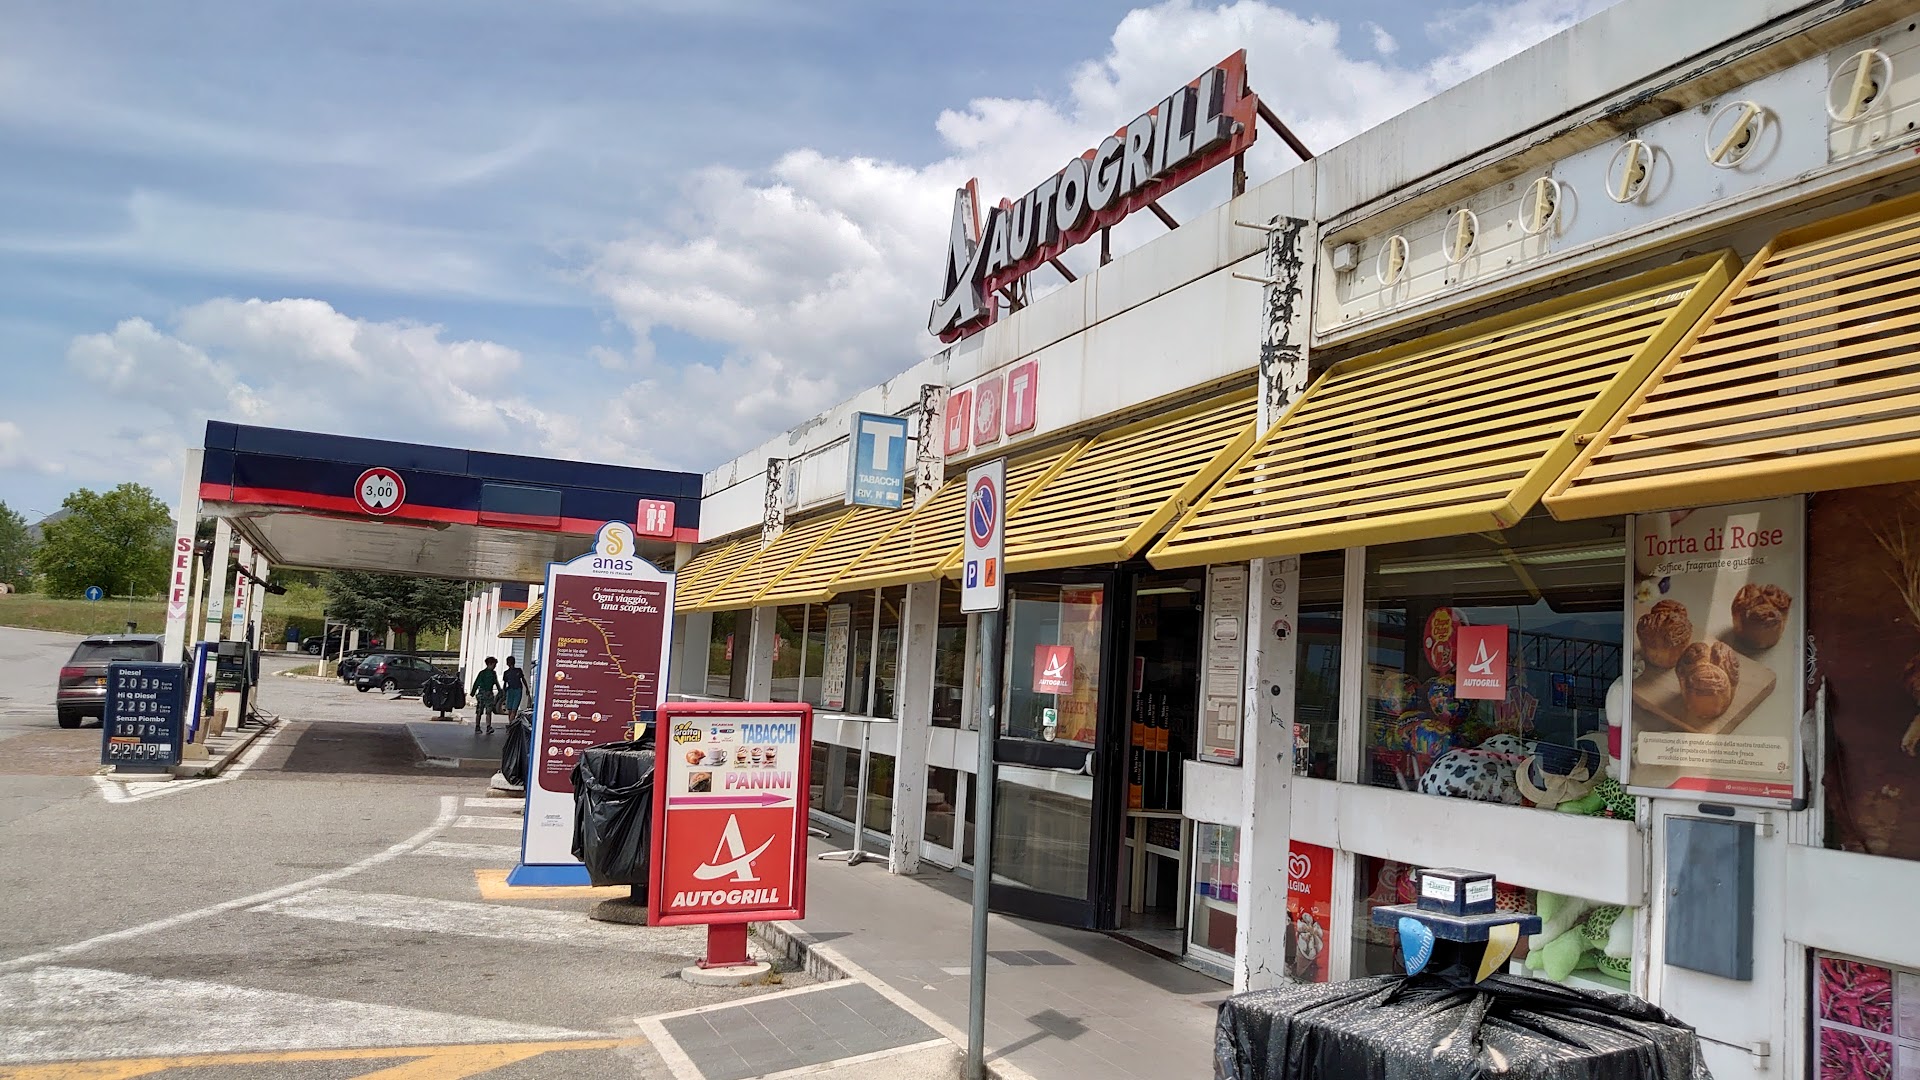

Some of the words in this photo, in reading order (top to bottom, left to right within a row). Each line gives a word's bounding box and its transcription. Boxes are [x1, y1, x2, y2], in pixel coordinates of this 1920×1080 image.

[984, 66, 1234, 278] AUTOGRILL
[862, 420, 904, 471] T
[859, 474, 900, 487] TABACCHI
[365, 486, 393, 498] 3,00
[857, 488, 873, 498] RIV.
[1644, 533, 1698, 557] Torta
[1703, 527, 1724, 552] di
[1731, 526, 1783, 549] Rose
[173, 537, 191, 602] SELF
[593, 557, 633, 571] anas
[1657, 562, 1685, 574] Soffice,
[1685, 559, 1726, 573] fragrante
[1732, 556, 1765, 570] gustosa
[967, 564, 977, 583] P
[592, 592, 614, 604] Ogni
[615, 594, 649, 605] viaggio,
[600, 603, 618, 611] una
[620, 603, 658, 614] scoperta.
[118, 678, 160, 689] 2.039
[1463, 679, 1500, 687] AUTOGRILL
[116, 701, 158, 712] 2.299
[116, 724, 156, 735] 1.979
[741, 723, 796, 744] TABACCHI
[725, 771, 792, 790] PANINI
[1288, 879, 1311, 895] LGIDA
[671, 887, 779, 908] AUTOGRILL
